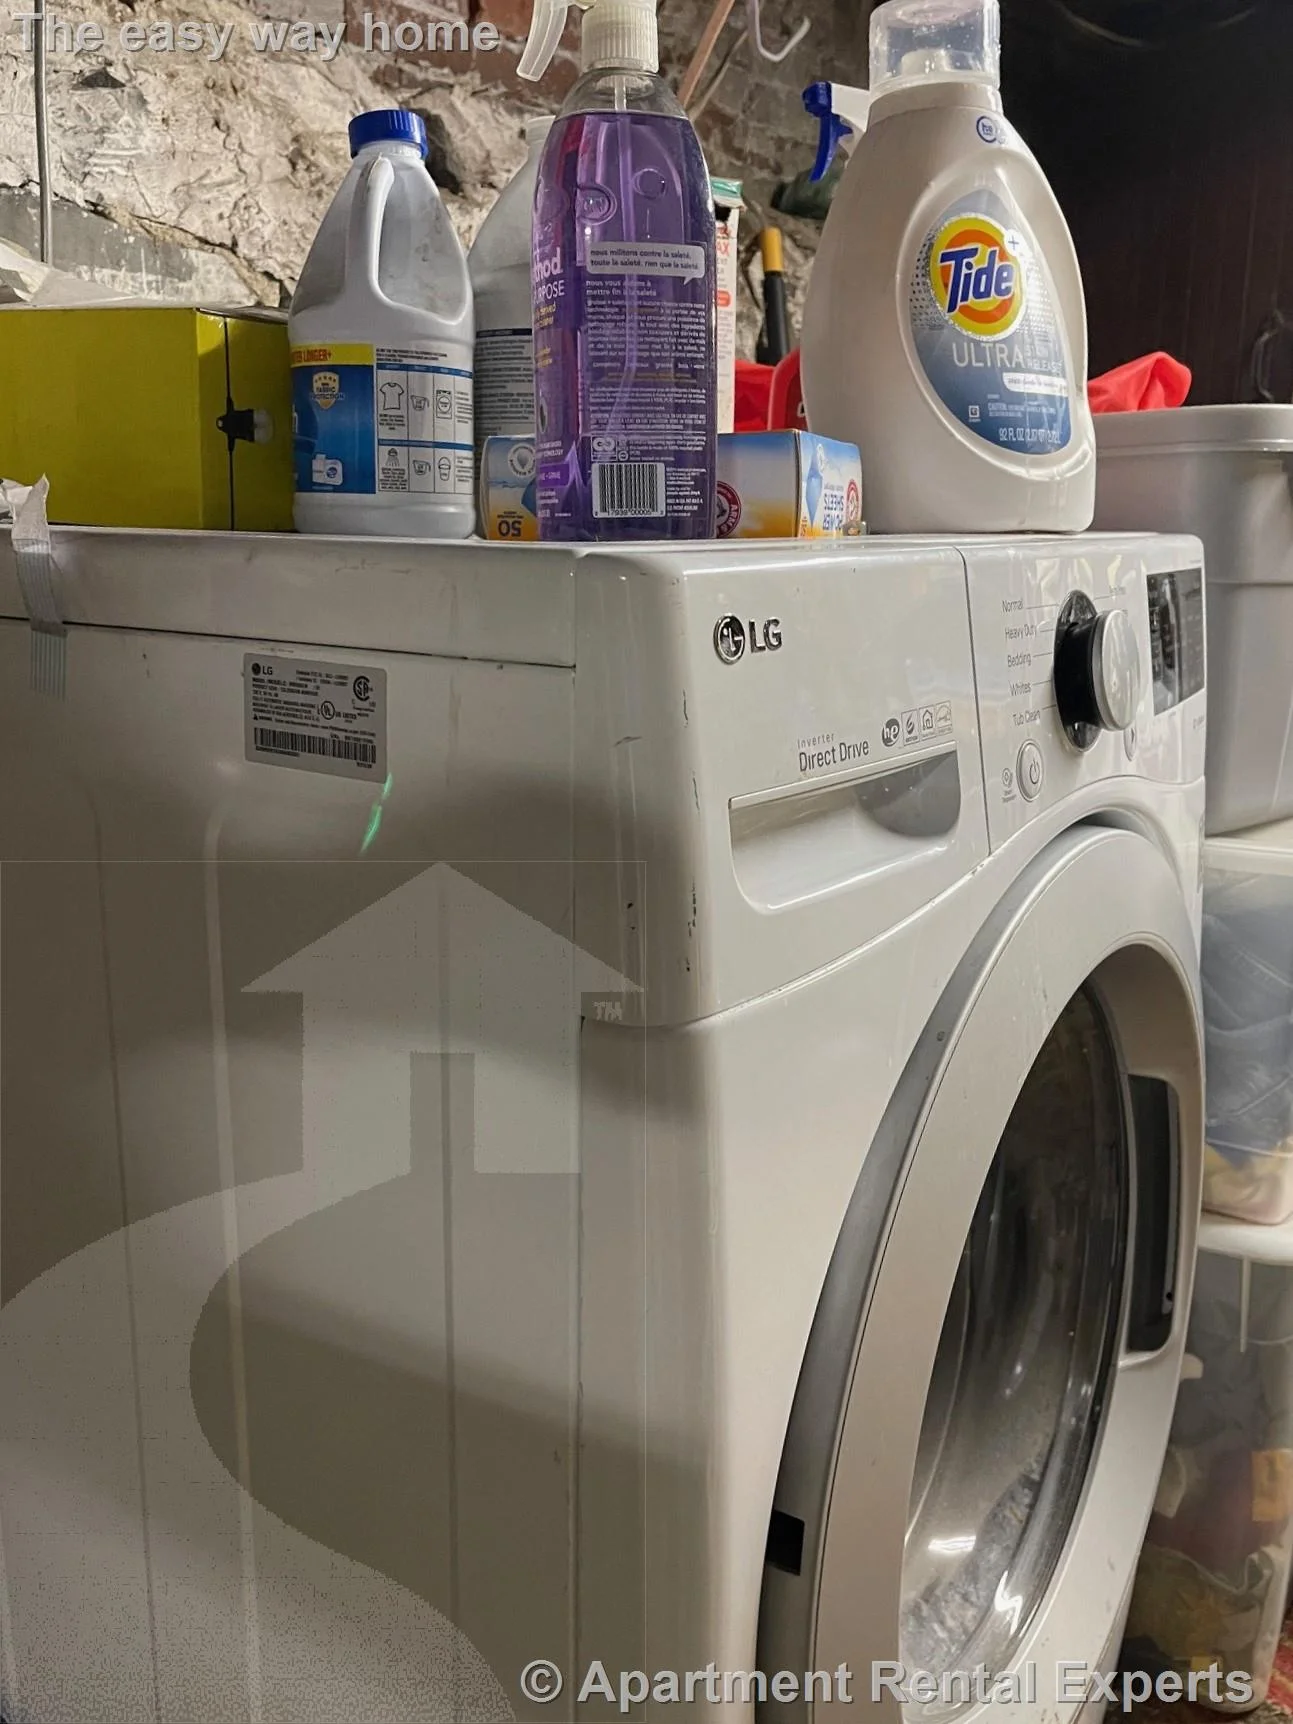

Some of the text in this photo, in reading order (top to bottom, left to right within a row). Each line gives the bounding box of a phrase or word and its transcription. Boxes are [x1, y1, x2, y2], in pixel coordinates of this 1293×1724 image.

[609, 248, 638, 257] militons
[639, 249, 662, 258] contre
[663, 250, 670, 258] la
[940, 246, 1015, 314] Tide
[952, 342, 1026, 369] ULTRA
[999, 427, 1007, 441] 92
[1008, 428, 1016, 441] FL
[1016, 428, 1025, 441] OZ
[1002, 599, 1024, 613] Normal
[748, 617, 783, 654] LG
[1004, 626, 1024, 641] Heavy
[1007, 652, 1032, 668] Bedding
[262, 666, 273, 675] LG
[1008, 680, 1032, 696] Whites
[1012, 712, 1025, 726] Tub
[797, 731, 836, 750] Inverter
[799, 739, 870, 772] Direct Drive
